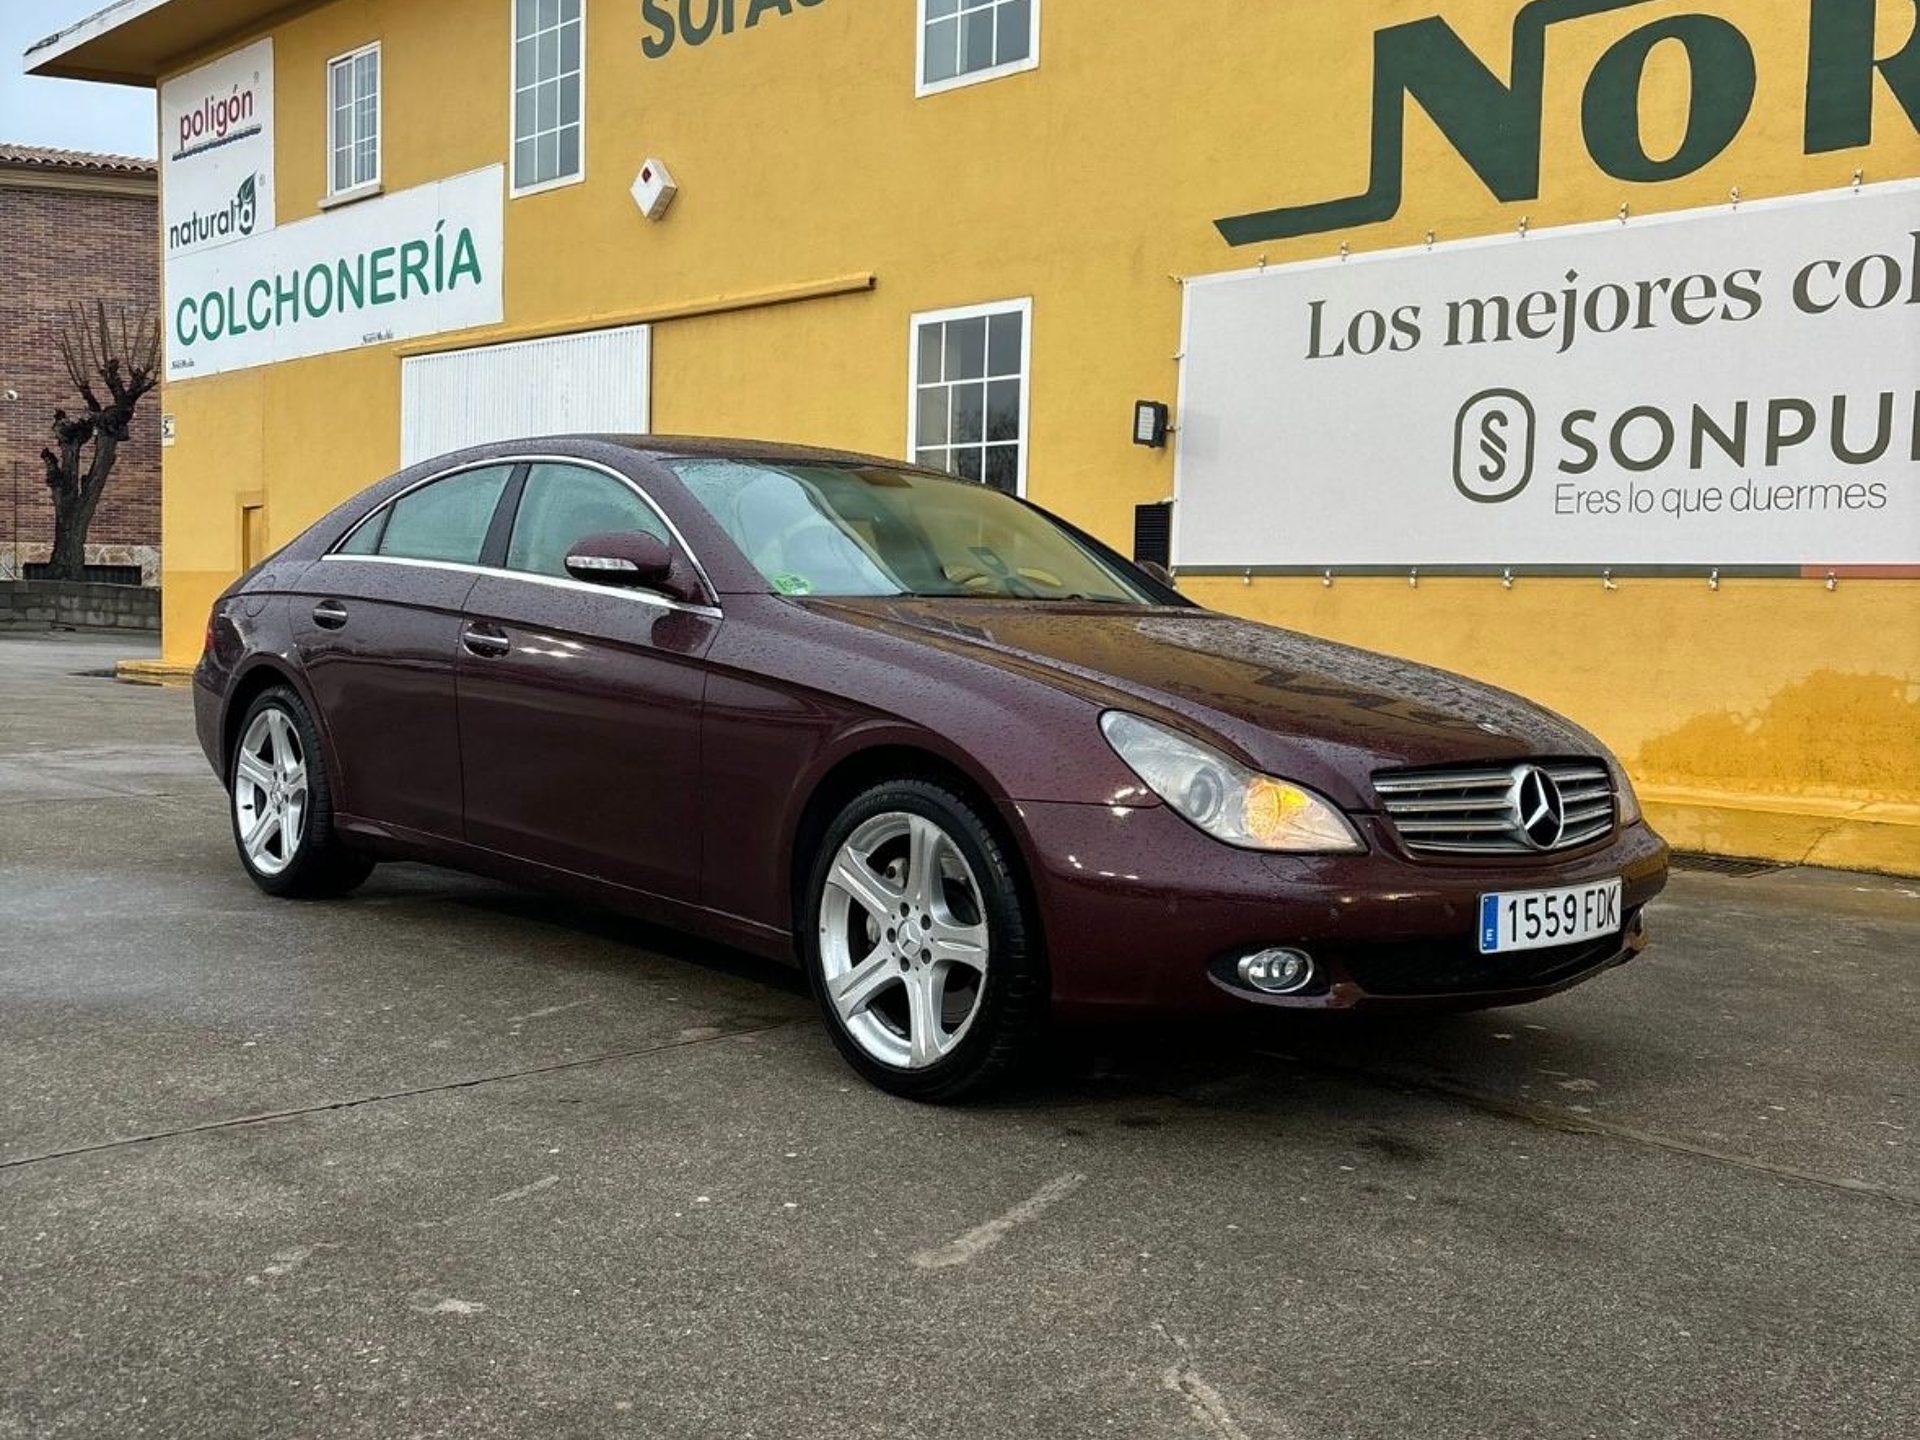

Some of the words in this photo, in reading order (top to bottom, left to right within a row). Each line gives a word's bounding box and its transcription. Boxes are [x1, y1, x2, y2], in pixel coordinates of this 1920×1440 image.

[180, 84, 254, 151] poligón
[176, 219, 482, 346] COLCHONERÍA
[1305, 299, 1421, 359] Los
[1443, 268, 1763, 354] mejores
[1557, 390, 1920, 475] SONPU
[1554, 482, 1622, 515] Eres
[1628, 480, 1655, 513] lo
[1661, 486, 1723, 519] que
[1730, 478, 1888, 512] duermes
[1485, 928, 1495, 942] E
[1508, 893, 1578, 943] 1559
[1584, 884, 1617, 933] FDK
